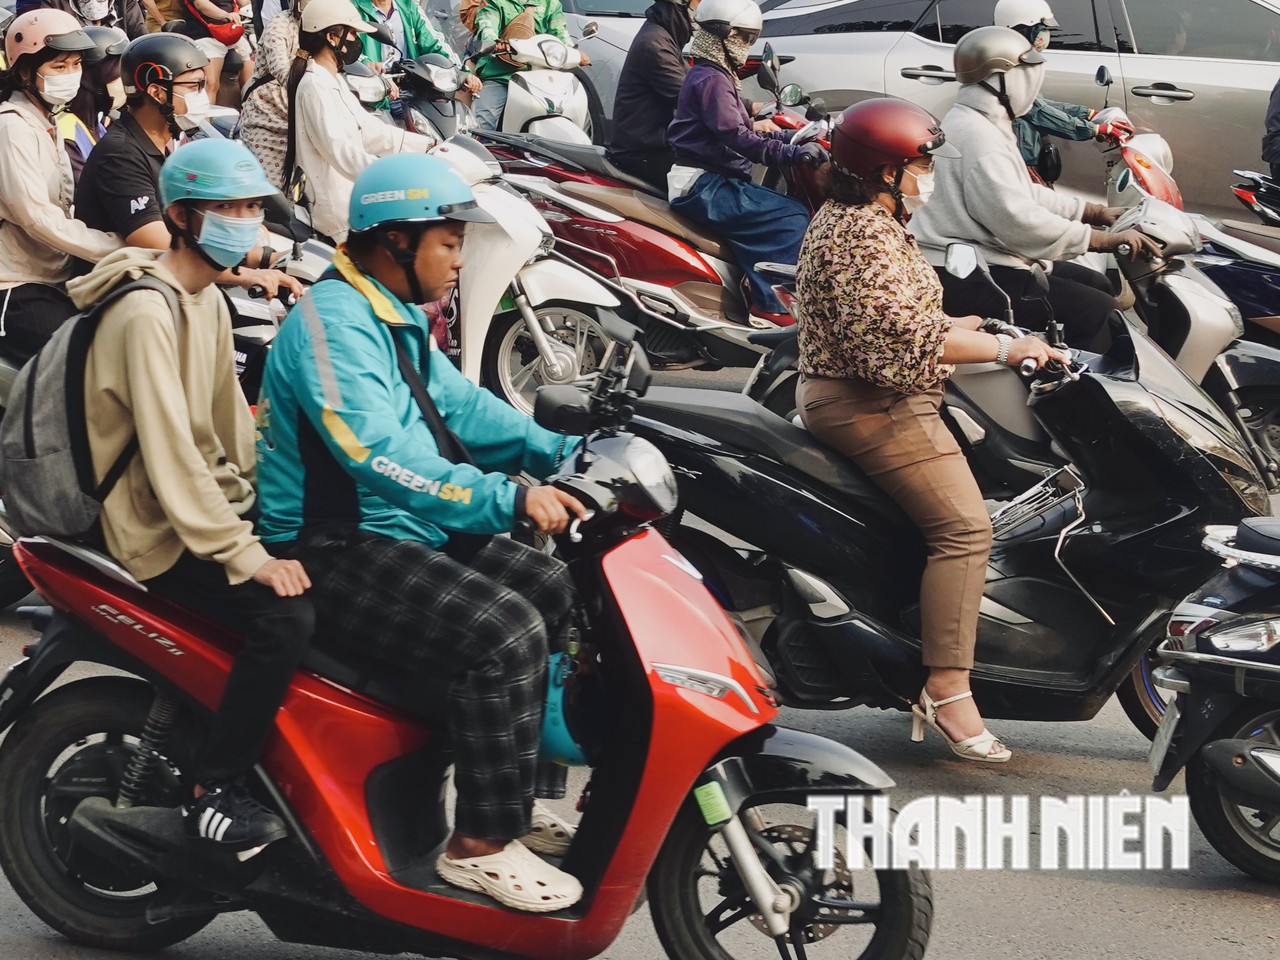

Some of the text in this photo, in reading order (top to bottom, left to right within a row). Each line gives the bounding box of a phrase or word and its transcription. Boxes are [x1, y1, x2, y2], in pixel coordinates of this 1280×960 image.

[360, 188, 429, 205] GREEN SM
[370, 455, 473, 505] GREEN SM
